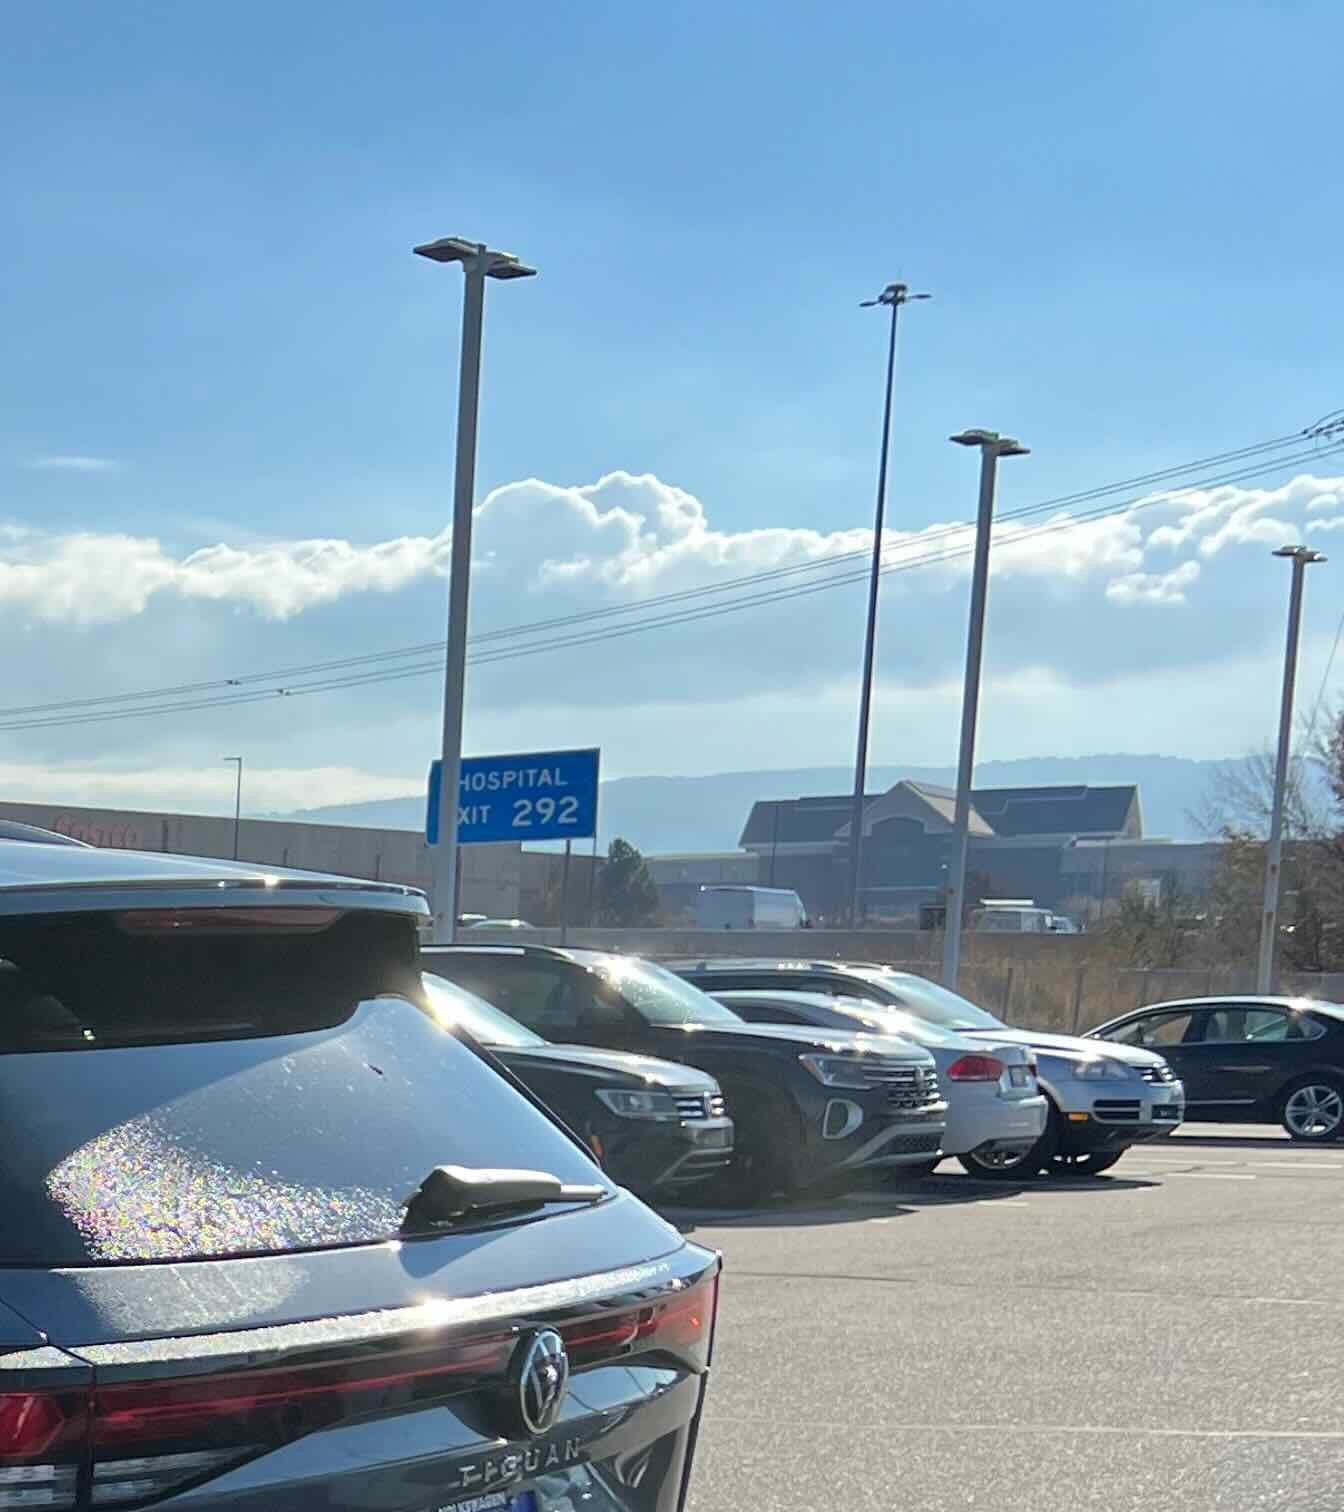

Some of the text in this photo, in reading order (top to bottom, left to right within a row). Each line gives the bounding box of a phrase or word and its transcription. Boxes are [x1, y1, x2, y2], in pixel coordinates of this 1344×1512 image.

[459, 767, 568, 792] HOSPITAL
[457, 795, 580, 827] XIT 292
